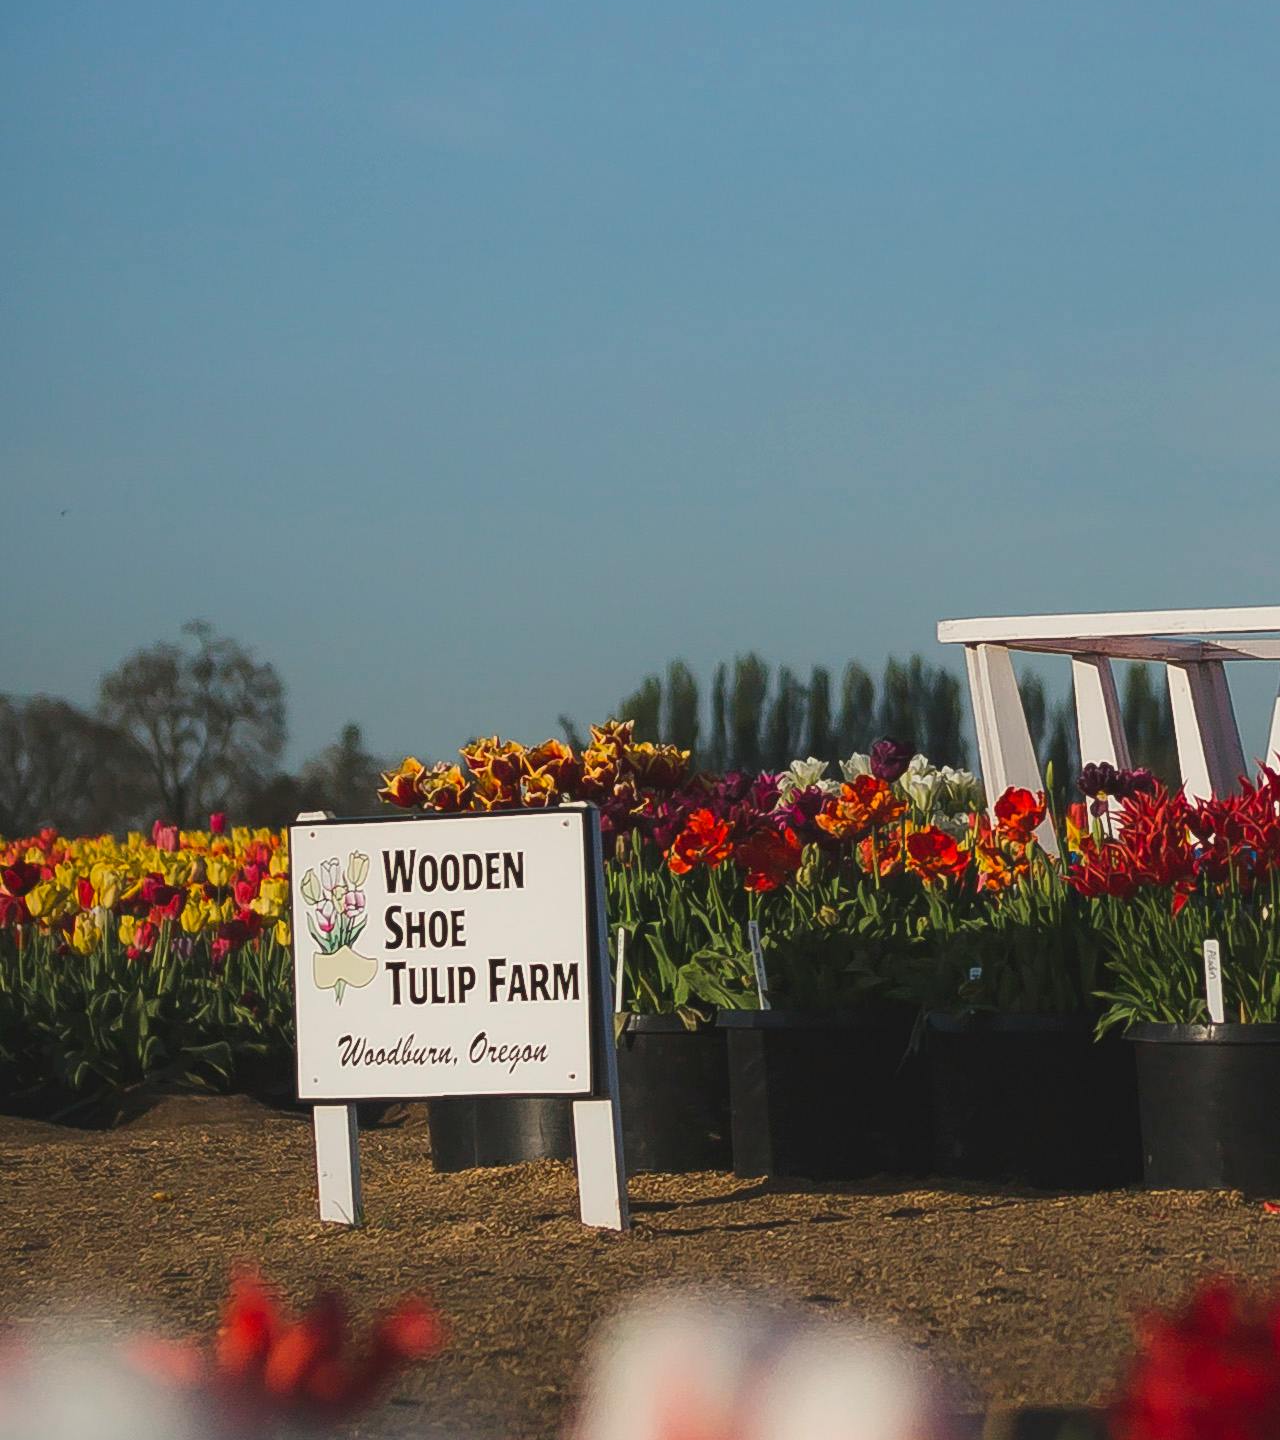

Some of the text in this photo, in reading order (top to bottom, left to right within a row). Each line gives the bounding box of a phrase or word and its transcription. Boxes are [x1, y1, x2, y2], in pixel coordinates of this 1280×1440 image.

[381, 849, 524, 894] WOODEN
[384, 905, 467, 950] SHOE
[385, 958, 580, 1005] TULIP FARM
[337, 1031, 548, 1074] Woodburn, Oregon
